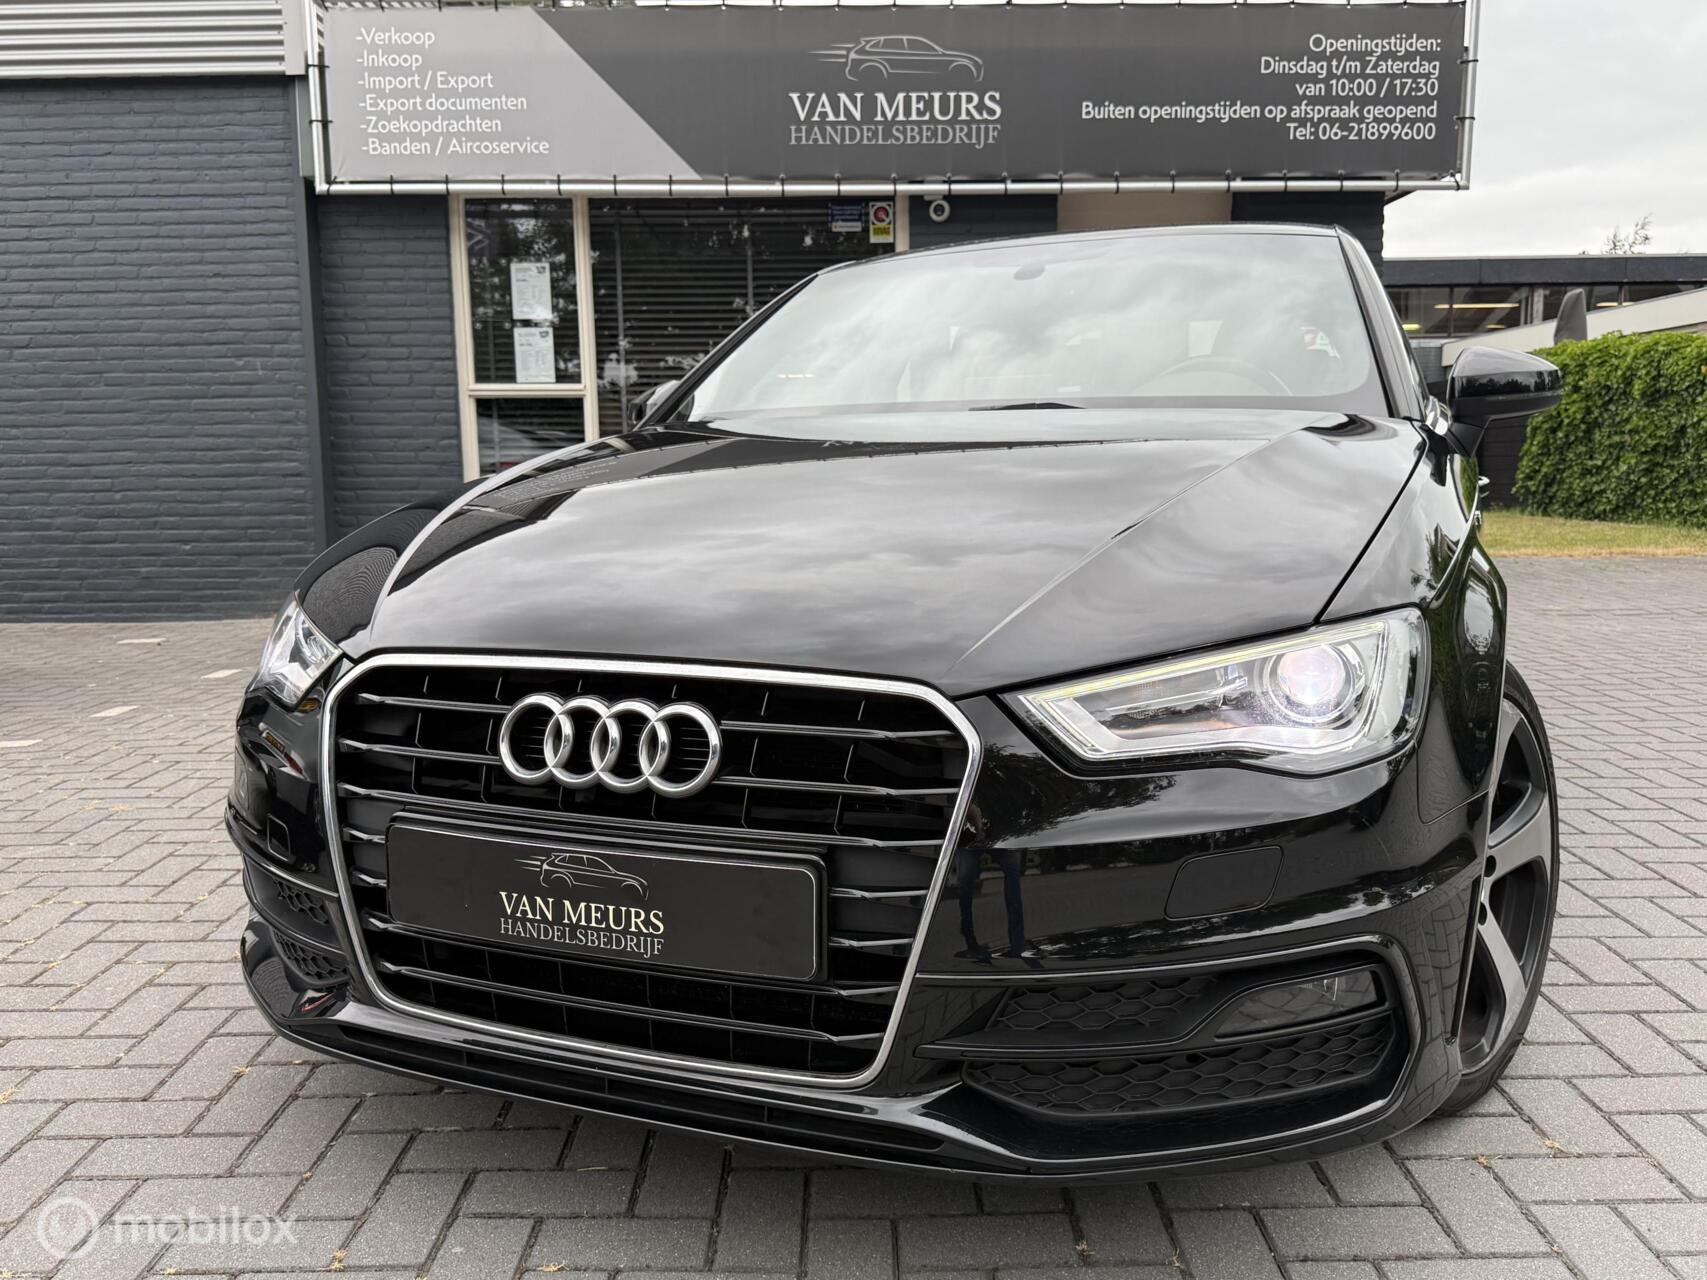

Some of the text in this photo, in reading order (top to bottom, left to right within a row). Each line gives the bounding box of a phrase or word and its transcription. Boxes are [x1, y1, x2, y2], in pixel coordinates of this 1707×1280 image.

[356, 27, 435, 48] -Verkoop
[1309, 34, 1441, 57] Openingstijden:
[357, 50, 423, 70] -Inkoop
[1260, 56, 1440, 78] Dinsdag t/m Zaterdag
[357, 71, 494, 92] -Import / Export
[1296, 78, 1439, 98] van 10:00 / 17:30
[359, 93, 527, 115] -Export documenten
[788, 90, 1002, 122] VAN MEURS
[1081, 101, 1438, 123] Buiten openingstijden op afspraak geopend
[360, 115, 502, 136] -Zoekopdrachten
[789, 124, 1001, 149] HANDELSBEDRIJF
[1286, 122, 1436, 141] Tel: 06-21899600
[361, 136, 550, 156] -Banden / Aircoservice
[499, 891, 665, 935] VAN MEURS
[499, 917, 665, 959] HANDELSBEDRIJF
